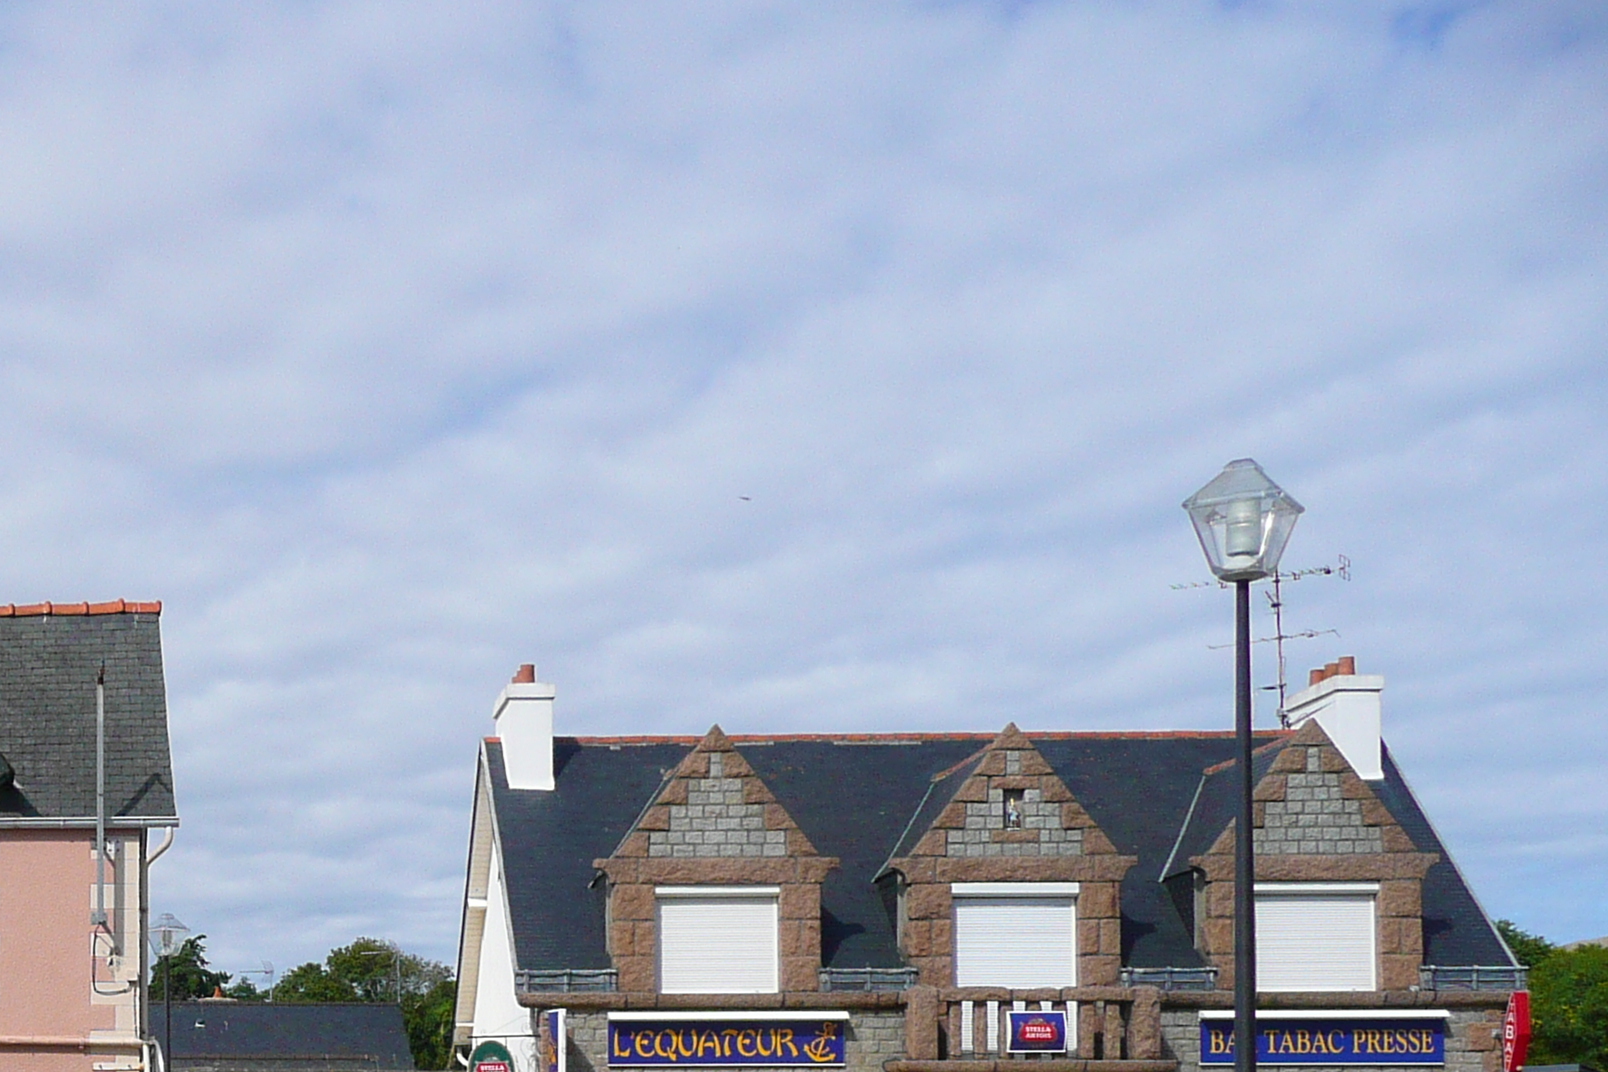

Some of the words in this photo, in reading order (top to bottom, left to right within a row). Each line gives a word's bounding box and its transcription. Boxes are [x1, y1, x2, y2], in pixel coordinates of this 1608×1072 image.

[613, 1028, 798, 1061] L'EQUATEUR
[1264, 1029, 1345, 1054] TABAC
[1352, 1029, 1435, 1054] PRESSE
